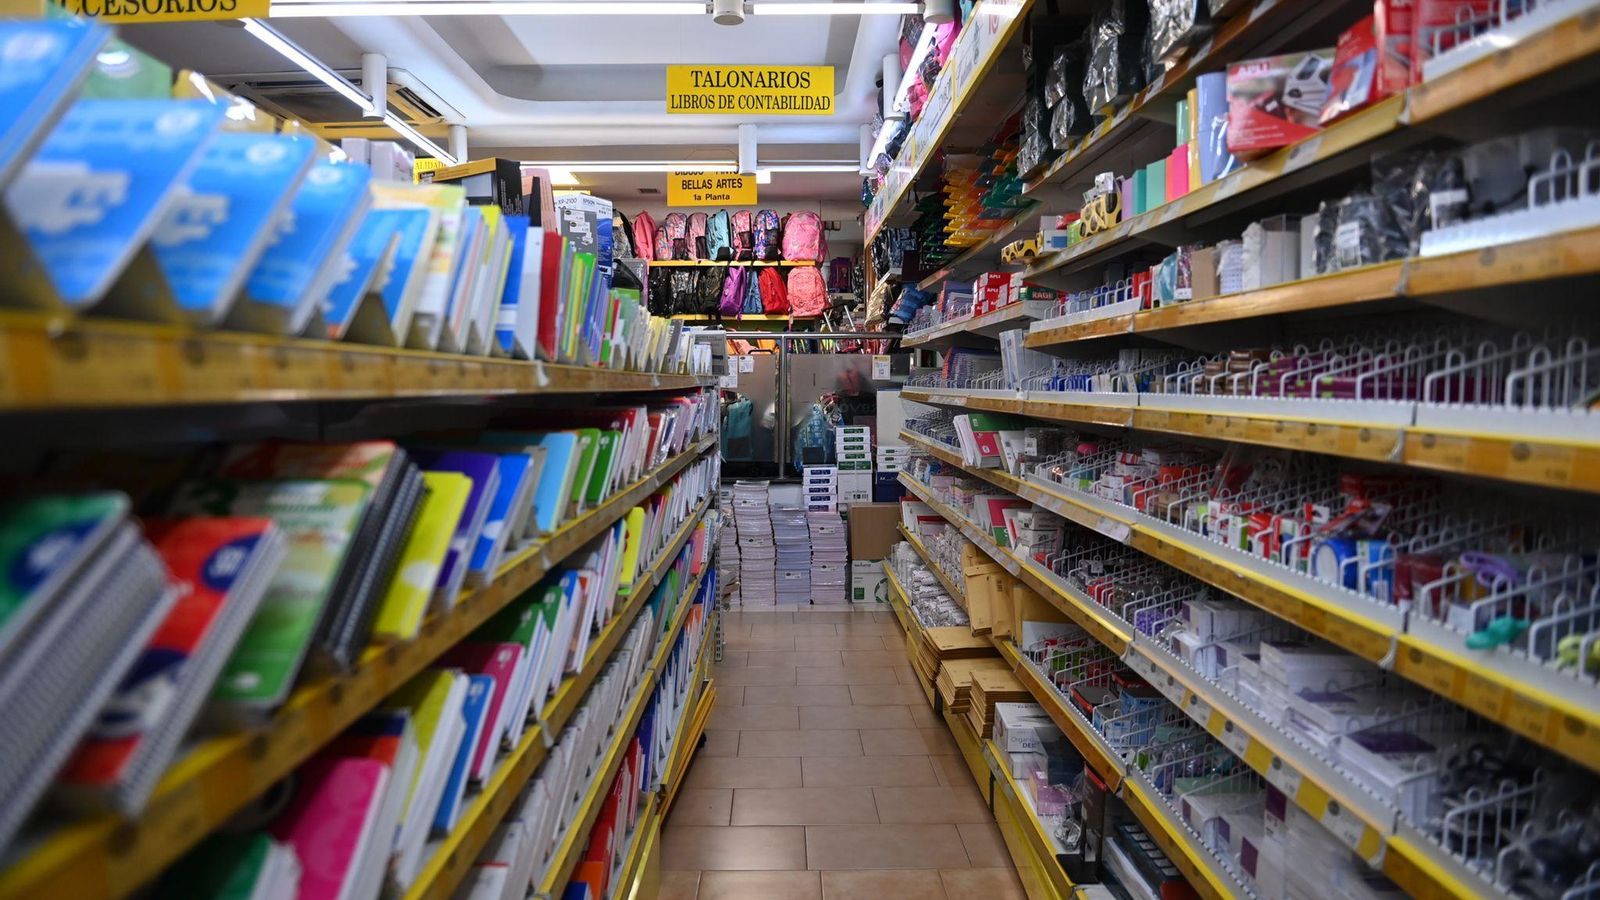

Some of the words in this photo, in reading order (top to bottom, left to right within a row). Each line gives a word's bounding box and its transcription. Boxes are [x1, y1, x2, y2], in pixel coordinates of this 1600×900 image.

[690, 70, 811, 89] TALONARIOS
[671, 94, 716, 109] LIBROS
[718, 94, 735, 109] DE
[738, 94, 831, 110] CONTABILIDAD
[681, 179, 713, 190] BELLAS
[716, 178, 743, 189] ARTES
[705, 193, 731, 201] Planta
